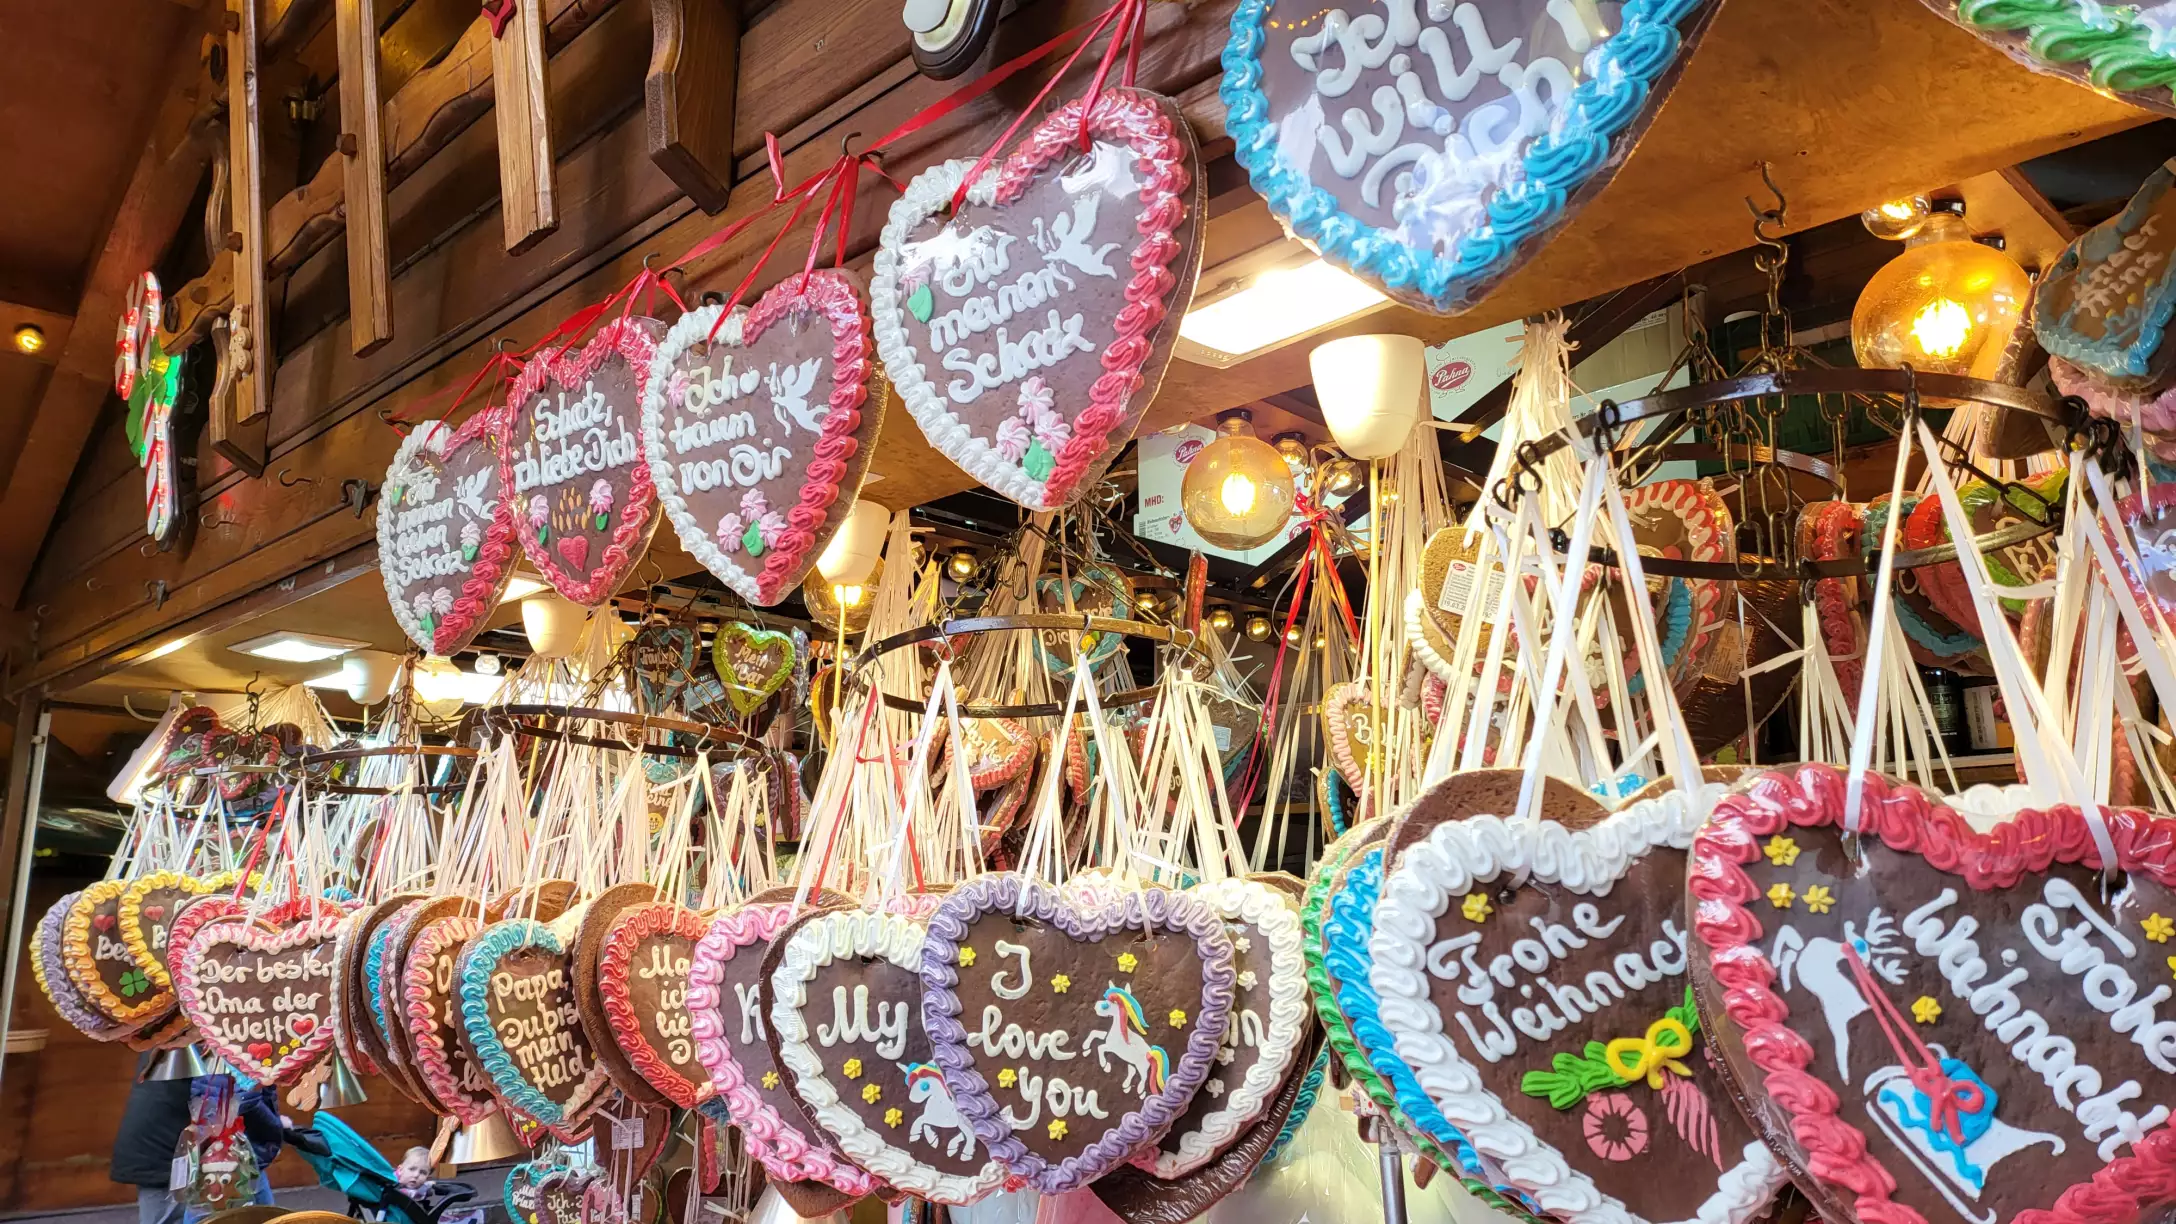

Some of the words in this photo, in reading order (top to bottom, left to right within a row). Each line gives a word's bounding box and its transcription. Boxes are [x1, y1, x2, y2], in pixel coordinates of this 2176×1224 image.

[928, 262, 1069, 352] meinen
[942, 309, 1097, 403] Schatz
[1434, 365, 1471, 388] Pahna
[582, 426, 638, 472] Dich
[678, 459, 734, 496] von
[728, 437, 793, 487] Dir
[1144, 494, 1165, 509] MHD:
[734, 645, 770, 669] Mein
[199, 959, 253, 984] Der
[1427, 902, 1626, 1006] Frohe
[204, 986, 265, 1014] Oma
[272, 986, 324, 1013] der
[491, 968, 569, 1014] Papa,
[221, 1015, 285, 1044] Welt
[497, 1016, 543, 1049] Du
[816, 984, 910, 1060] My
[966, 1004, 1077, 1061] love
[516, 1029, 574, 1068] mein
[529, 1045, 590, 1093] Held
